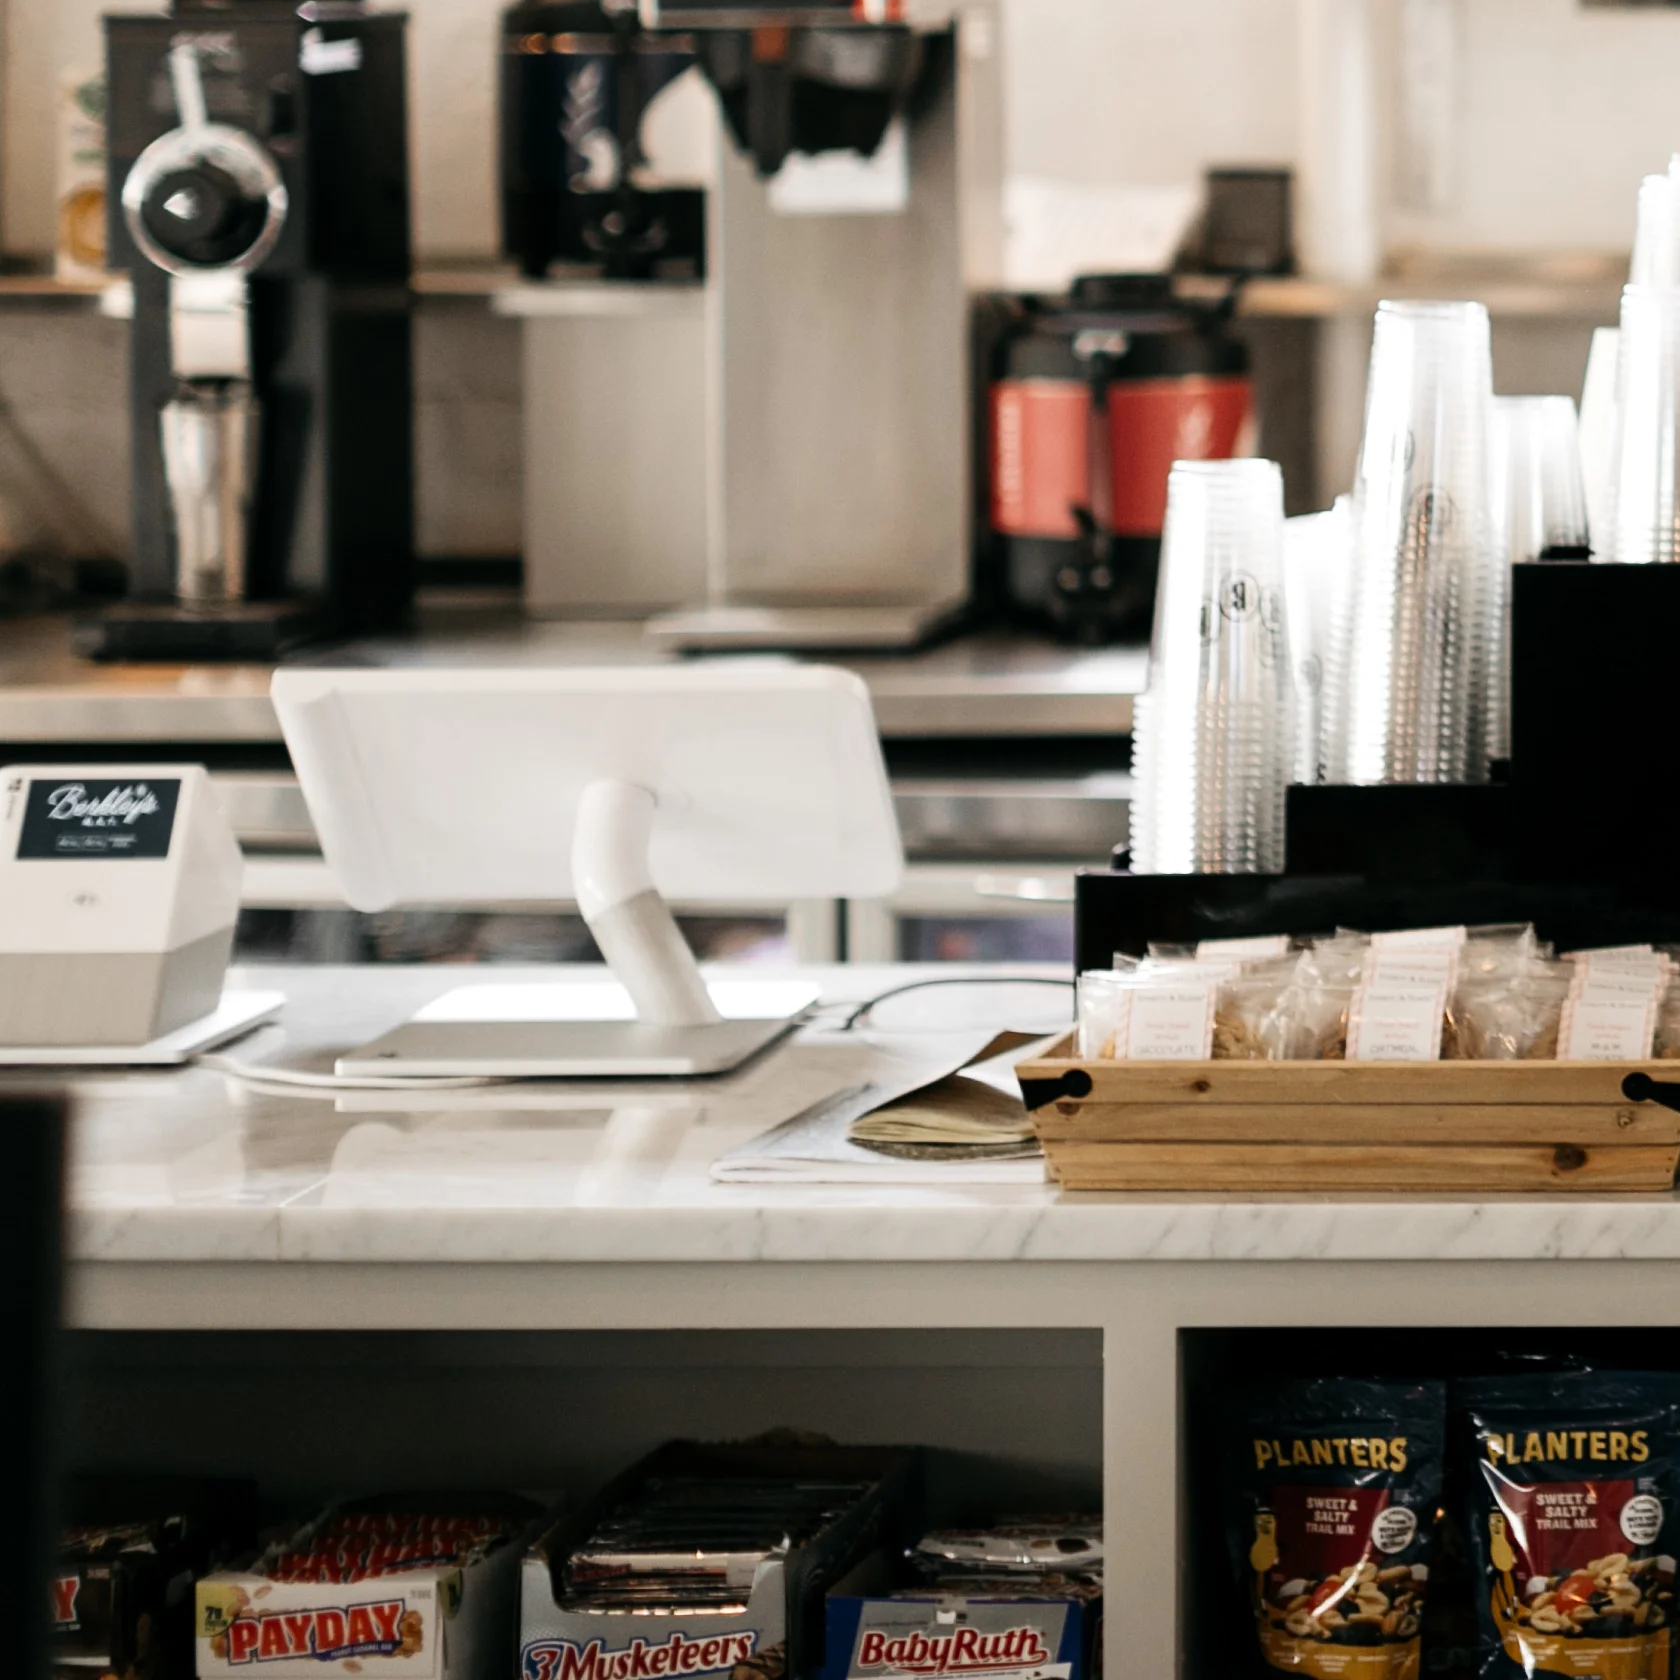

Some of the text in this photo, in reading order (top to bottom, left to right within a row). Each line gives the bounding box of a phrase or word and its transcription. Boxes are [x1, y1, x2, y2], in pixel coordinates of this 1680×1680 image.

[1254, 1437, 1408, 1472] PLANTERS
[1487, 1429, 1650, 1466] PLANTERS
[1305, 1497, 1358, 1511] SWEET &
[1536, 1493, 1598, 1506] SWEET &
[1314, 1510, 1351, 1524] SALTY
[1545, 1505, 1587, 1518] SALTY
[1305, 1522, 1357, 1536] TRAIL MIX
[1536, 1517, 1598, 1530] TRAIL MIX
[229, 1602, 404, 1662] PAYDAY
[524, 1630, 754, 1680] 3 Musketeers
